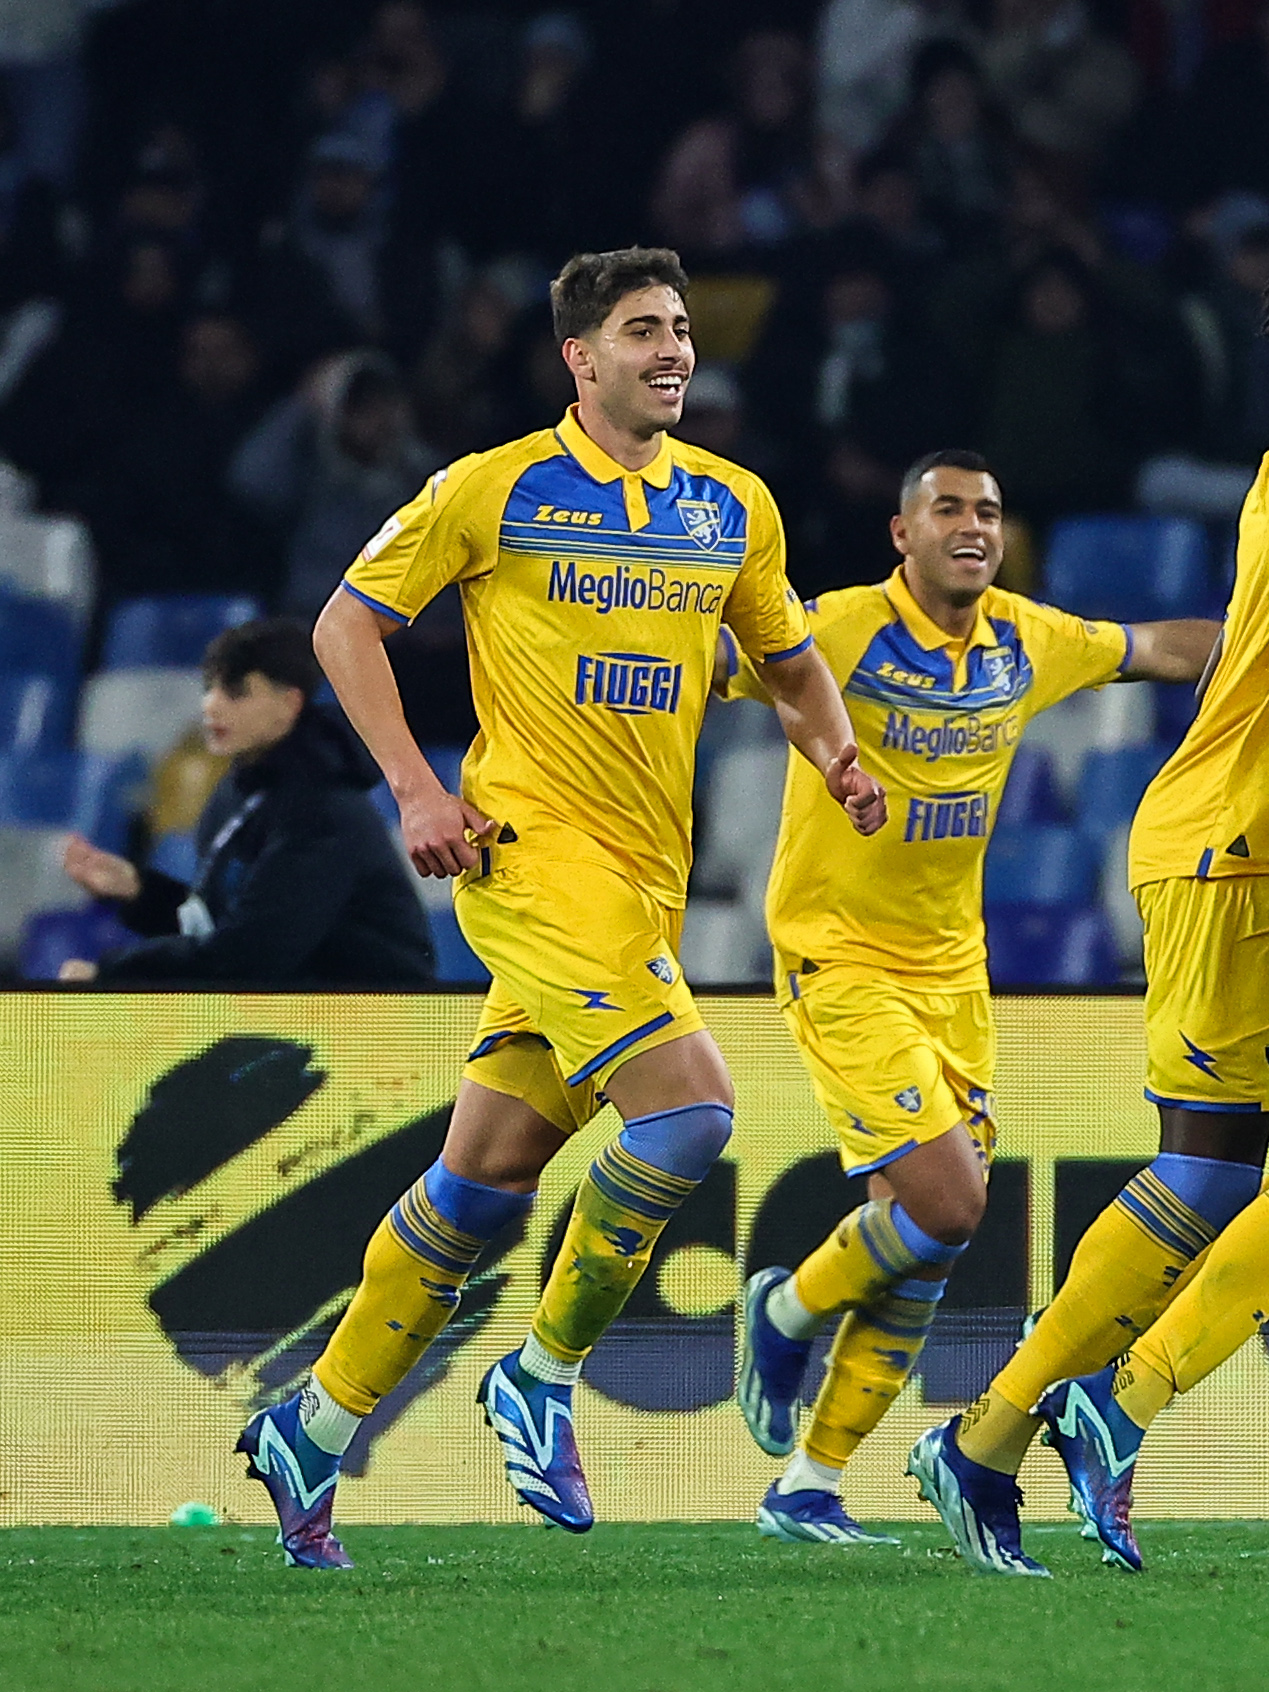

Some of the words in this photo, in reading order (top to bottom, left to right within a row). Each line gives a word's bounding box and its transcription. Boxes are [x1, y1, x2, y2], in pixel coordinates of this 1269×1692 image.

[533, 505, 603, 526] Zeus
[547, 561, 723, 614] MeglioBanca
[575, 654, 682, 714] FIUGGI
[876, 662, 936, 688] Zeus
[904, 791, 989, 842] FIUGGI
